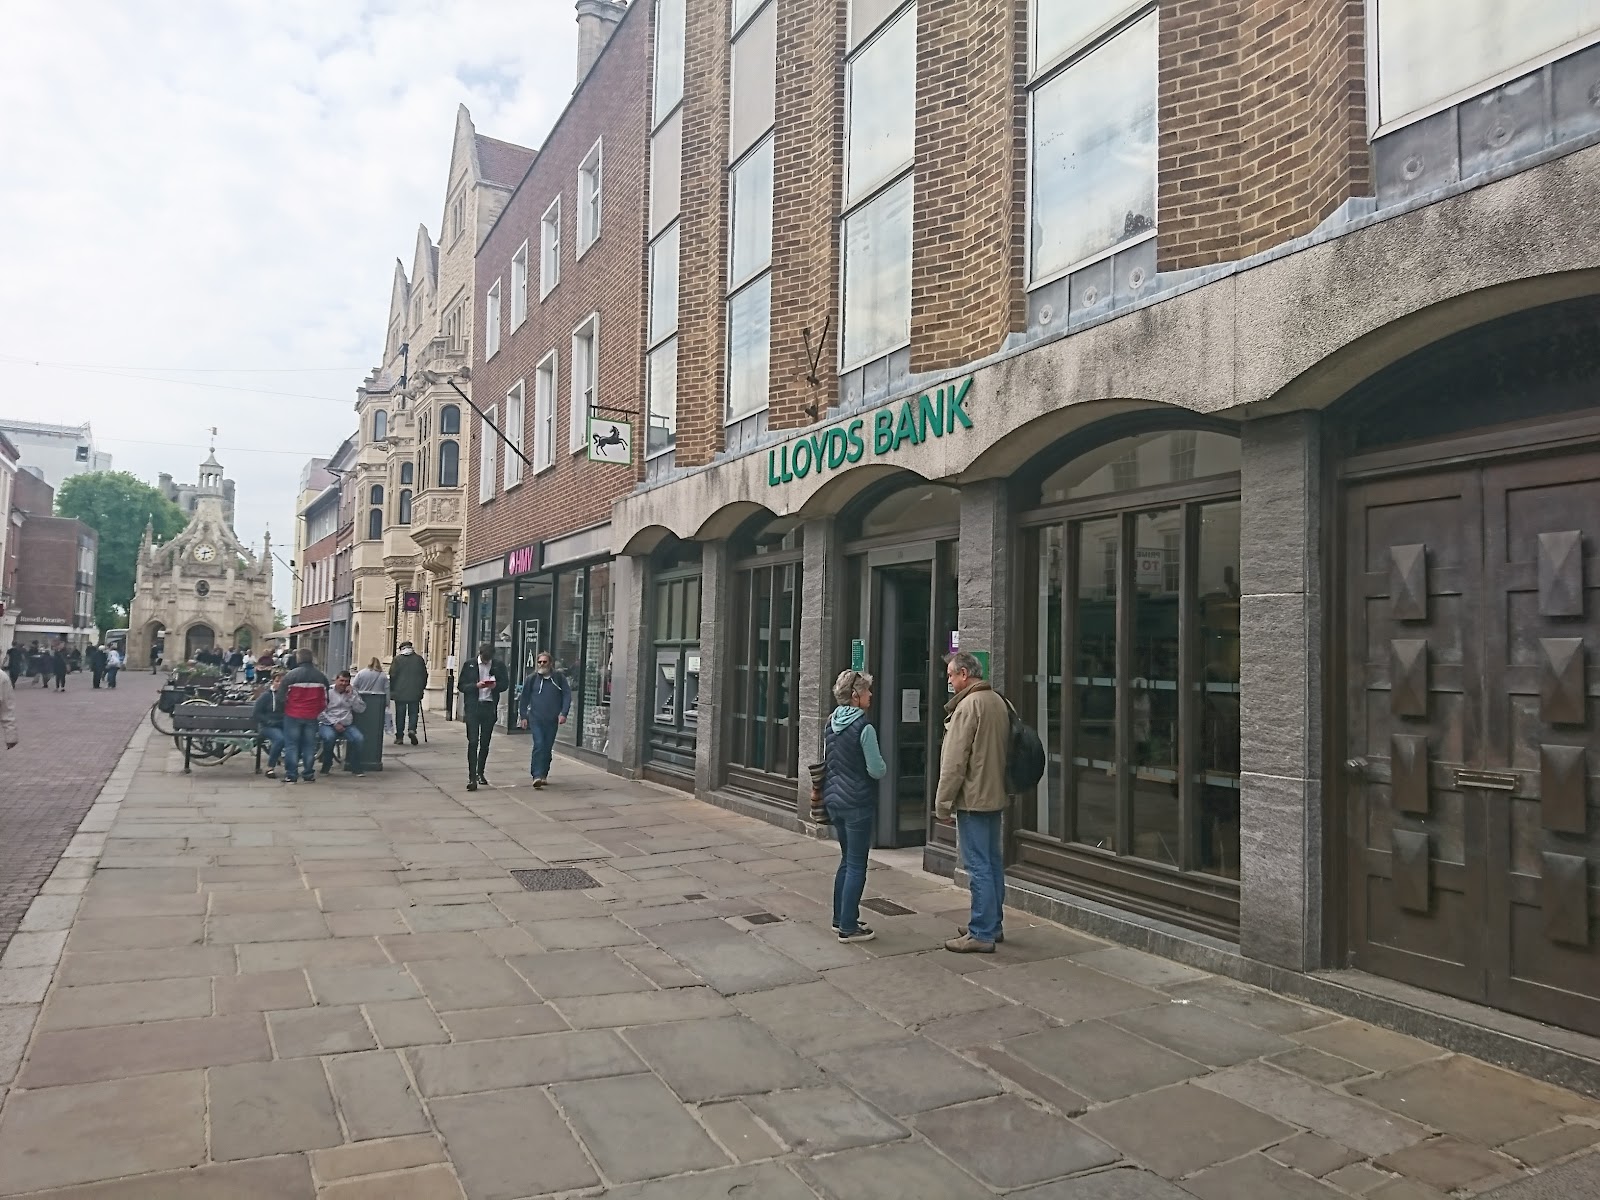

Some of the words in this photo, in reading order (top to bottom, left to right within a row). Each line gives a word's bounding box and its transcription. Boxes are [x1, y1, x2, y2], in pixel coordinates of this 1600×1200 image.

[768, 419, 865, 487] LLOYDS
[874, 376, 974, 456] BANK
[514, 545, 534, 575] HMV
